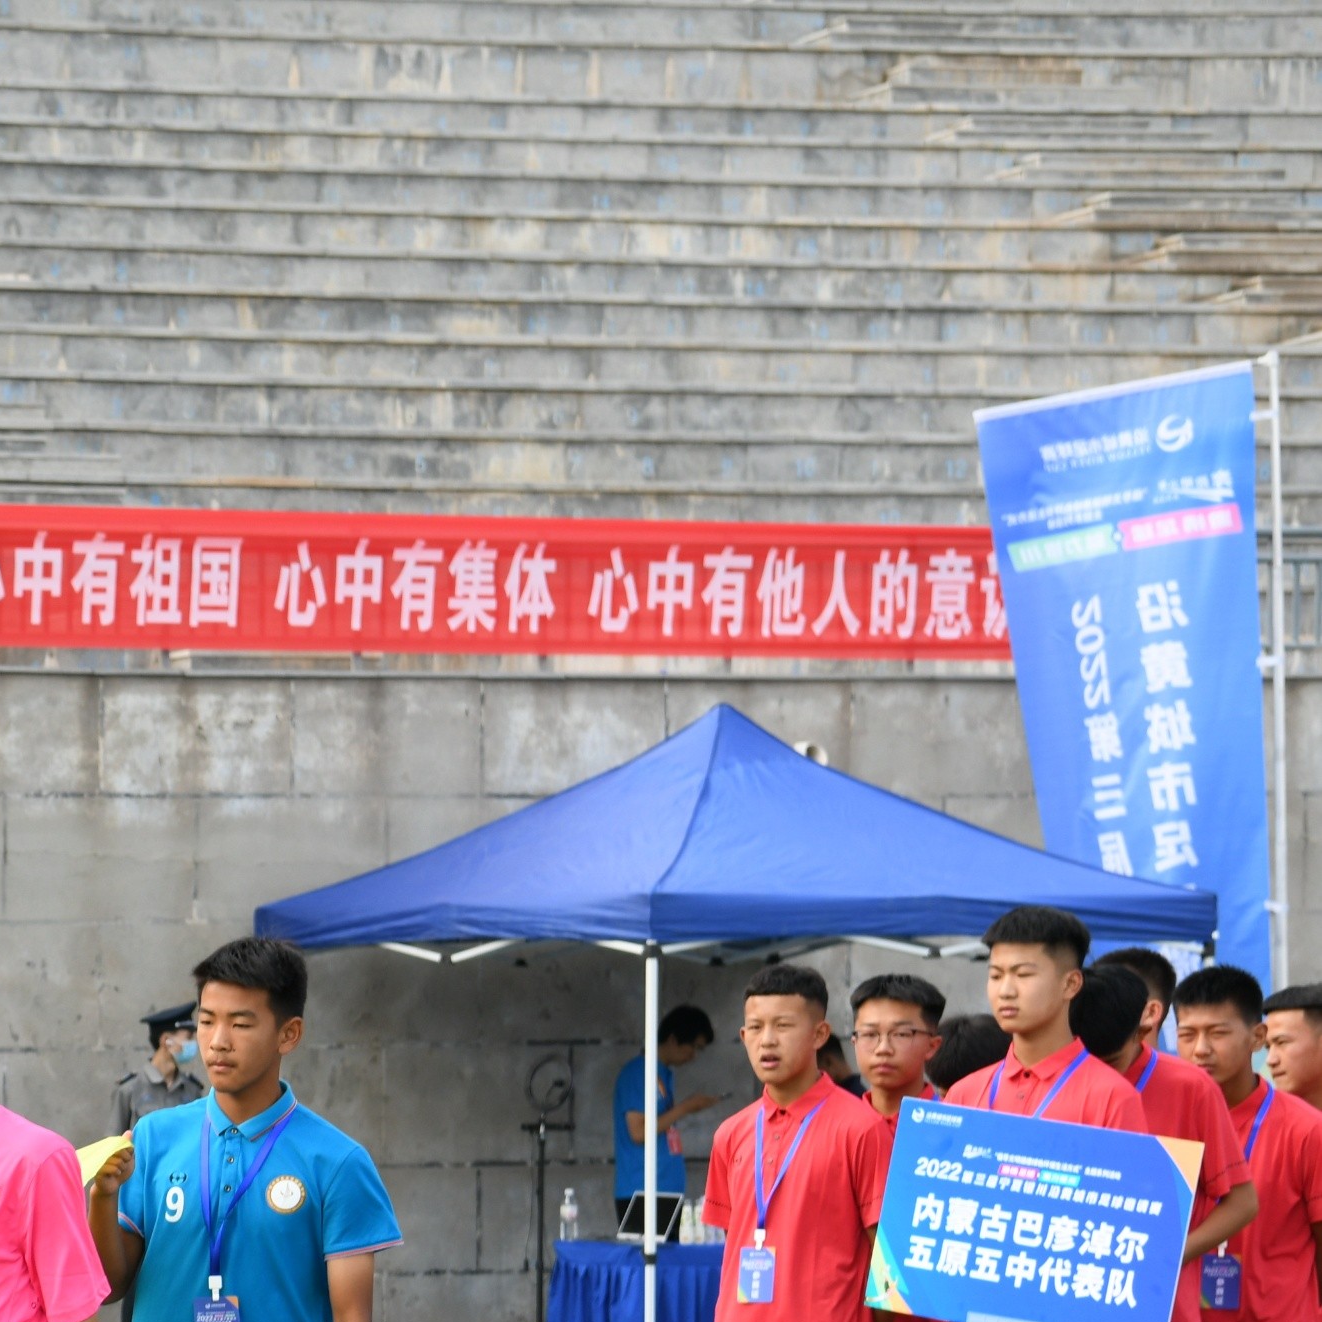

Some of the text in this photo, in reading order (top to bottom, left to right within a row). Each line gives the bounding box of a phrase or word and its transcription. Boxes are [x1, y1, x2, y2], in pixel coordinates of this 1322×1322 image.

[274, 538, 556, 634] 心中有集体
[164, 1186, 185, 1223] 9
[912, 1193, 1150, 1265] 内蒙古巴彦淖尔
[904, 1236, 1137, 1310] 五原五中代表队
